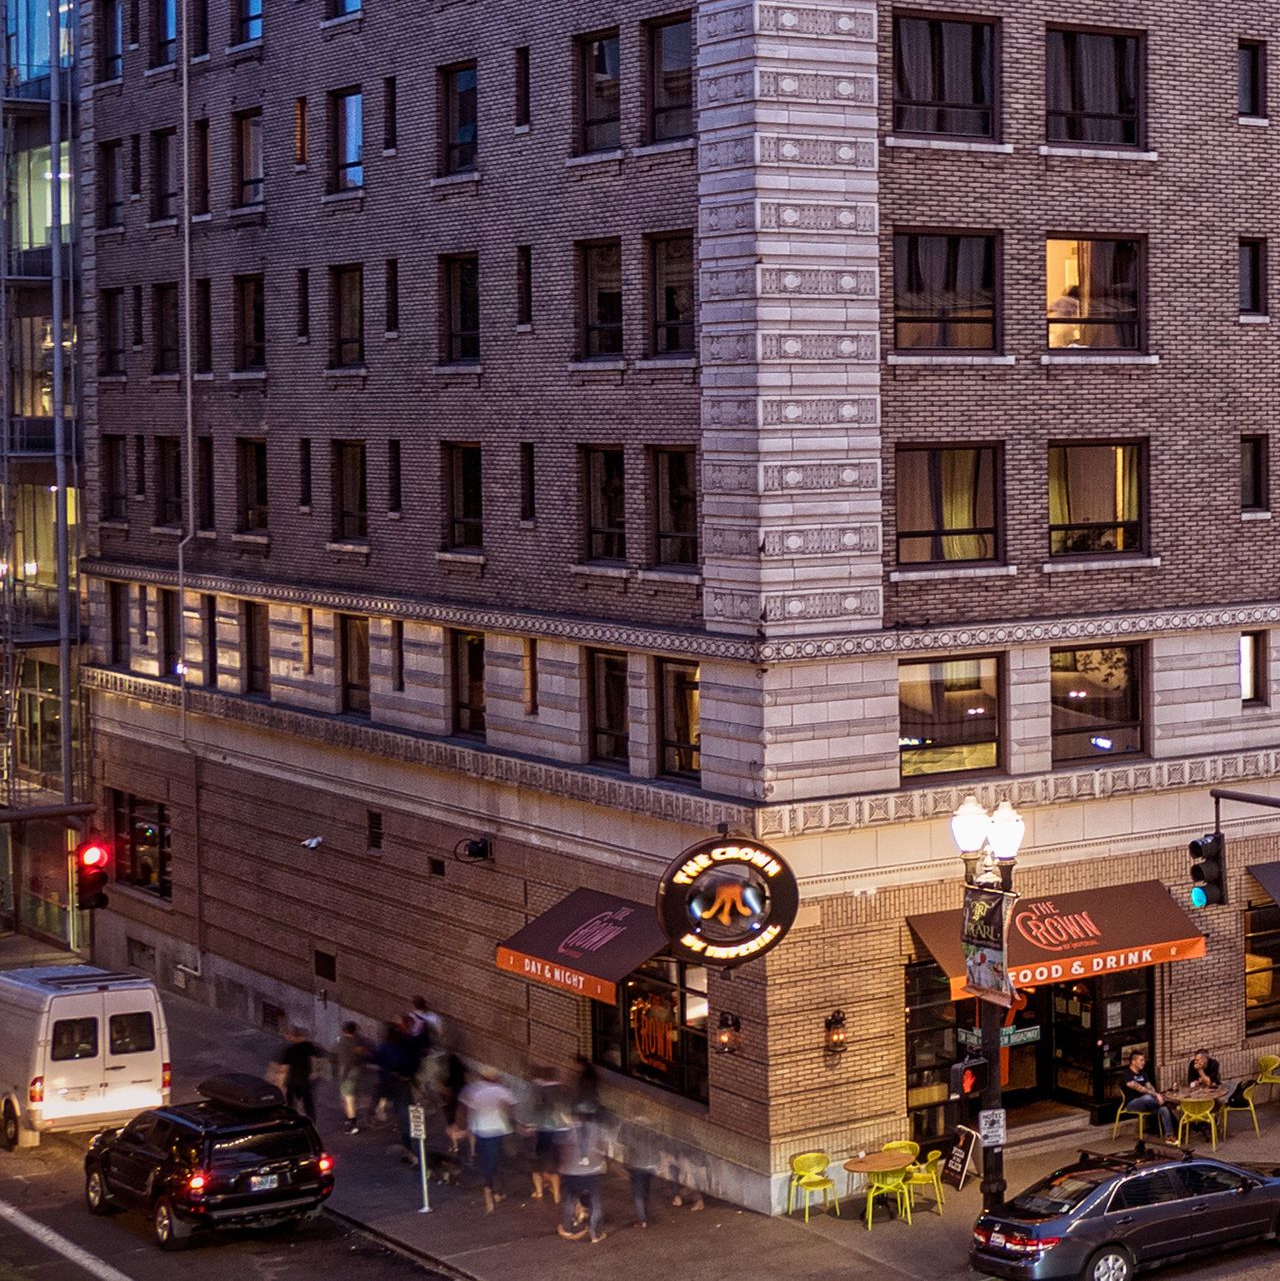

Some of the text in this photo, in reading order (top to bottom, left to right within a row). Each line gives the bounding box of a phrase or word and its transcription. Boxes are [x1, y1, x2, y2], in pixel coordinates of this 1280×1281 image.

[672, 846, 781, 884] THE CROWN
[1028, 901, 1059, 915] THE
[680, 924, 781, 958] BY IMPERIAL
[1016, 911, 1102, 951] CROWN
[523, 958, 586, 990] DAY & NIGHT
[1008, 948, 1154, 984] FOOD & DRINK
